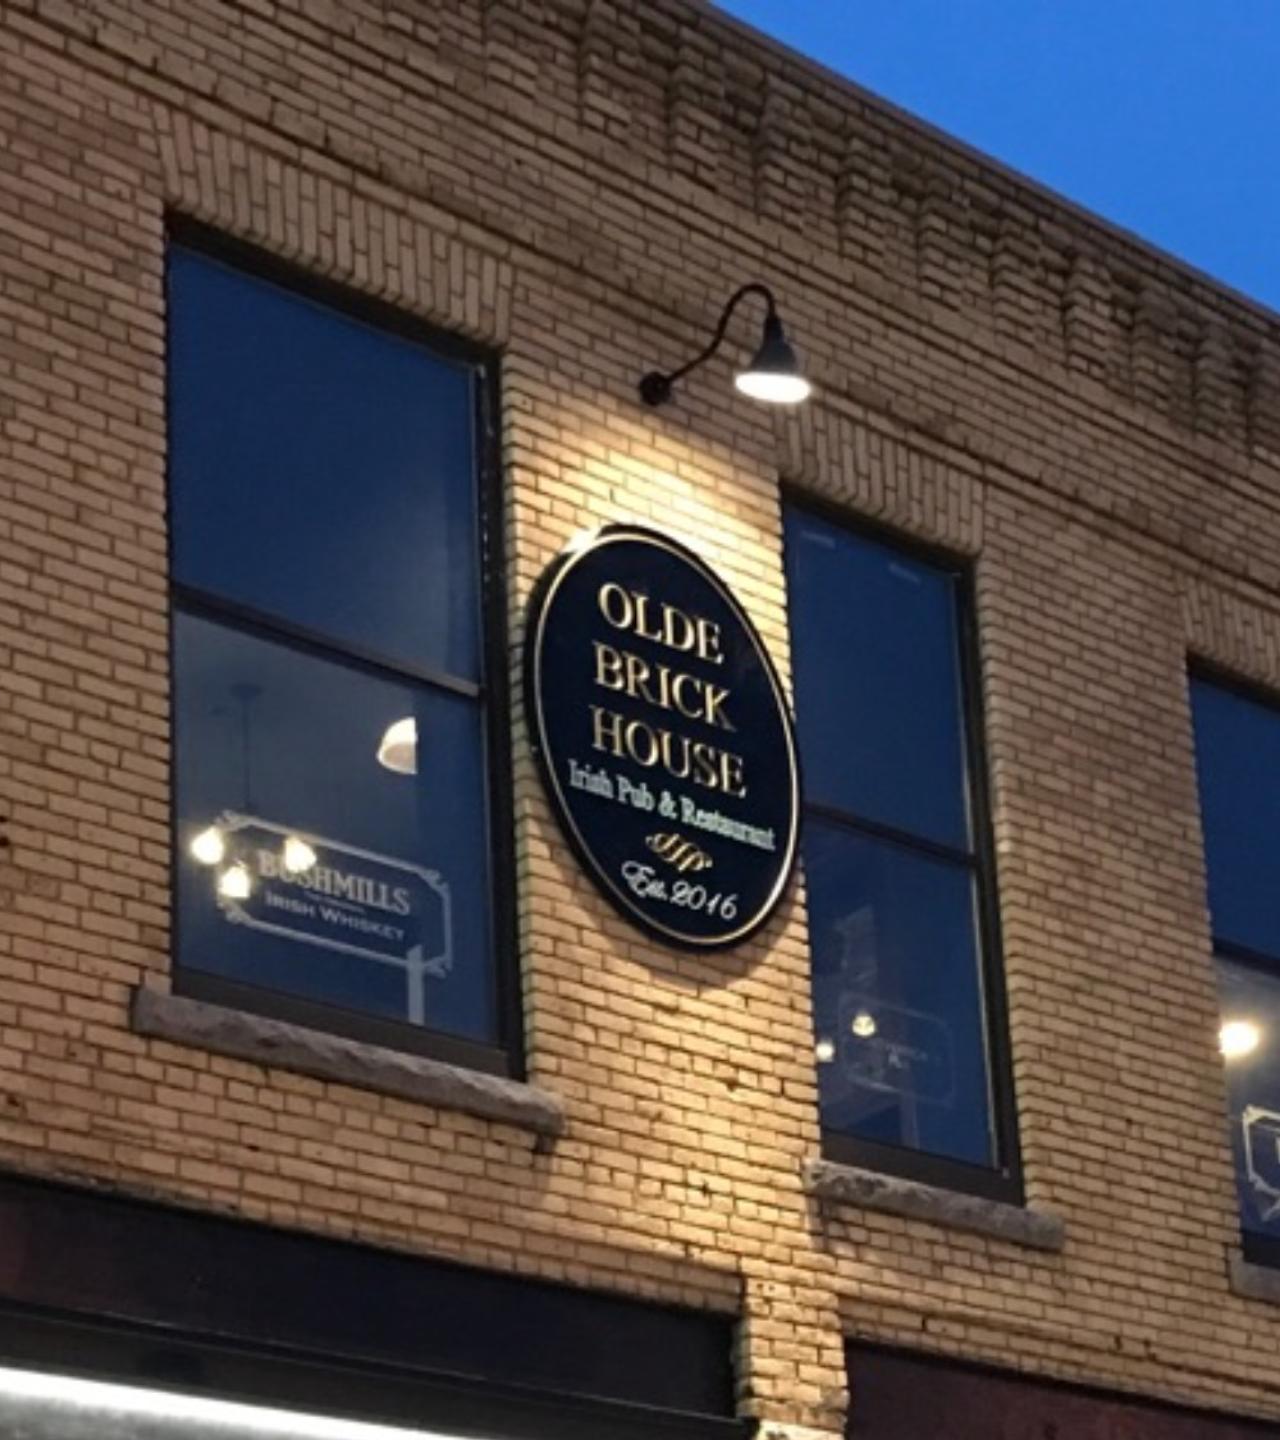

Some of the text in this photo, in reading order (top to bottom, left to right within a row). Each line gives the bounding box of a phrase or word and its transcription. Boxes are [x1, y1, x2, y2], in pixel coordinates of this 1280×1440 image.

[598, 582, 726, 664] OLDE
[592, 640, 738, 732] BRICK
[589, 704, 748, 799] HOUSE
[568, 758, 776, 851] Irish Pub & Restaurant
[669, 880, 738, 920] 2016
